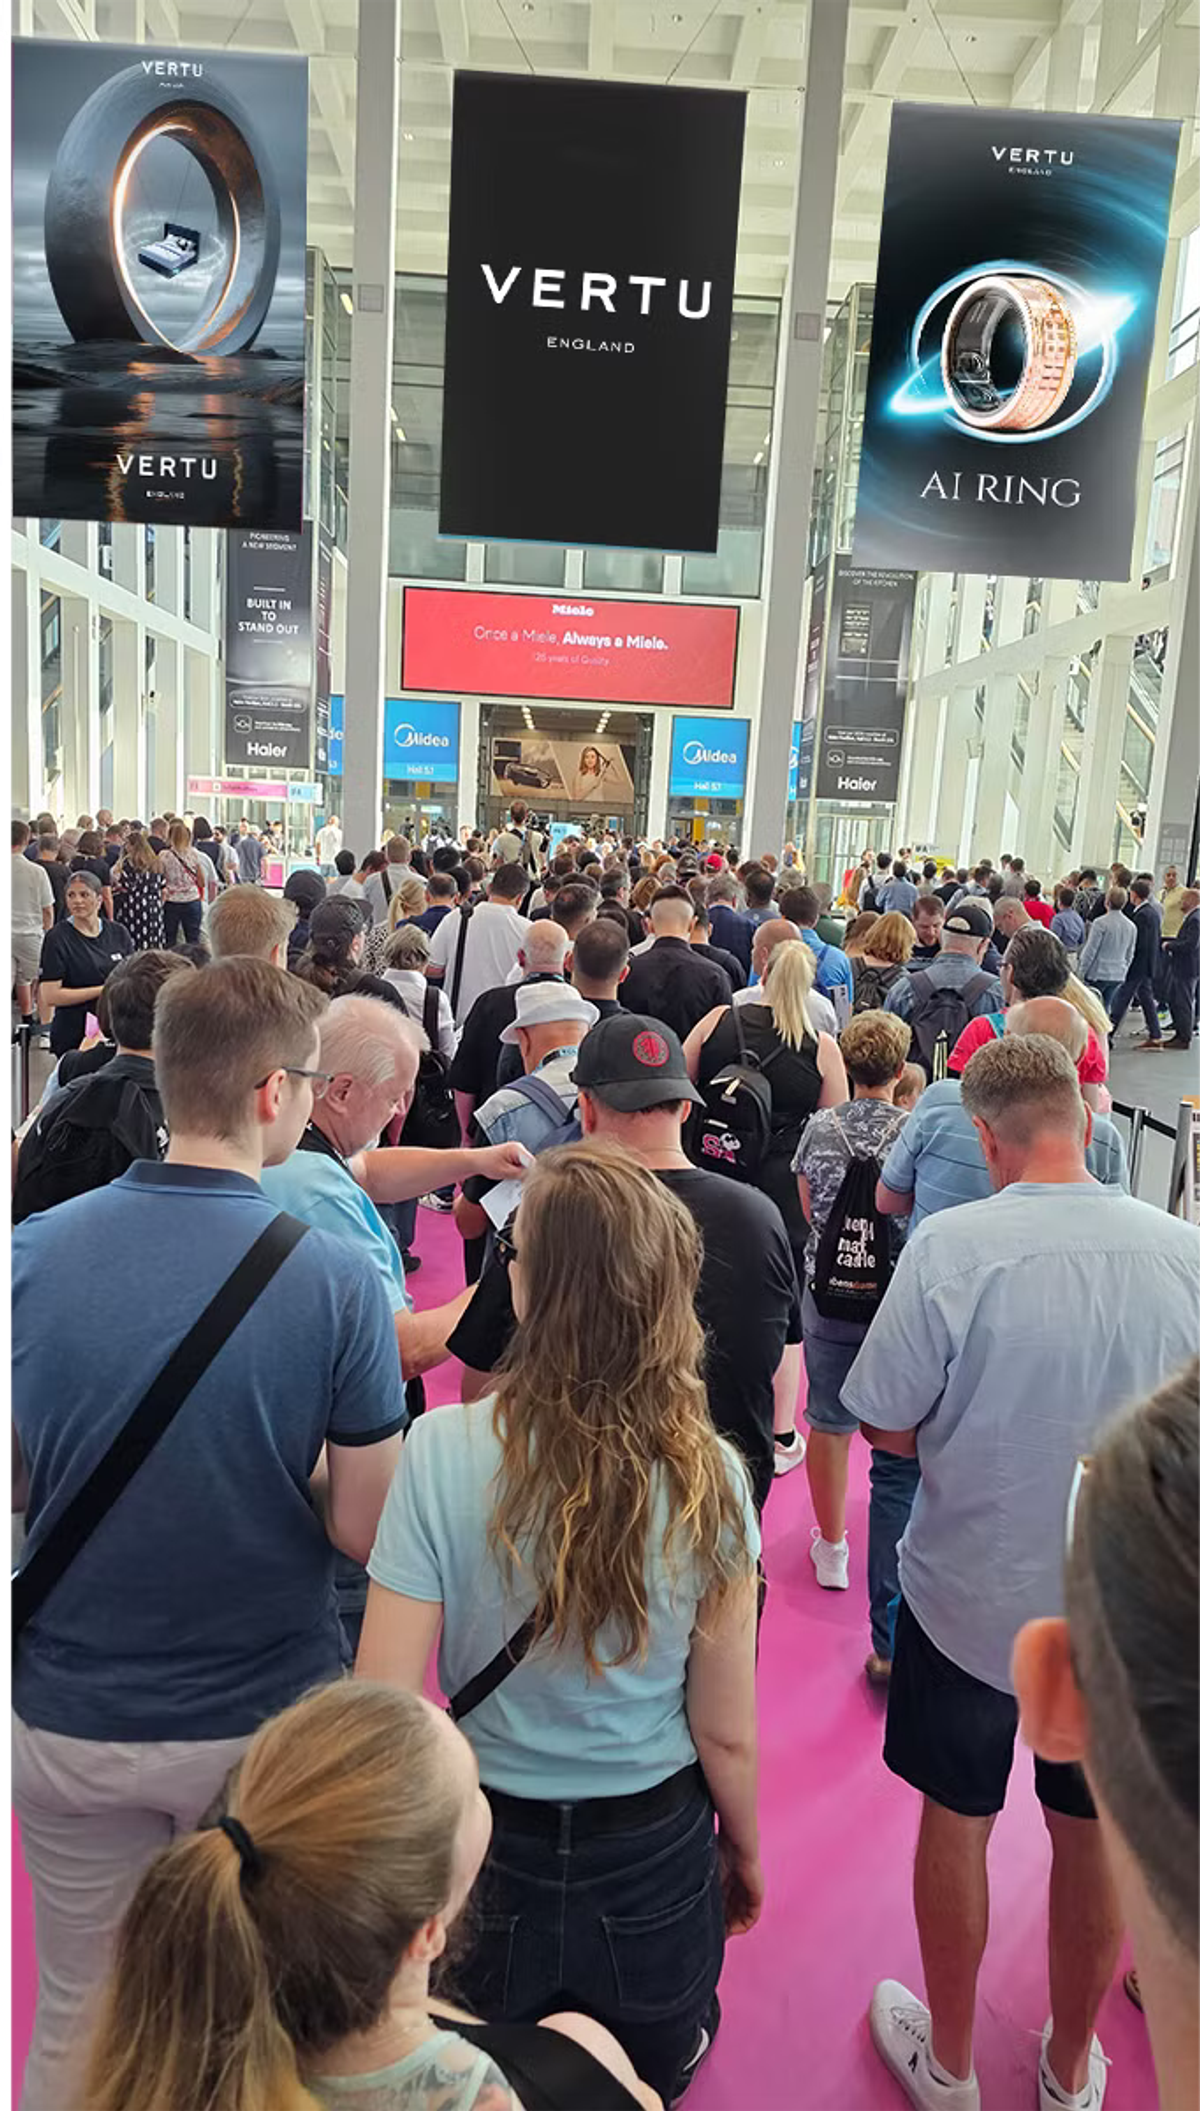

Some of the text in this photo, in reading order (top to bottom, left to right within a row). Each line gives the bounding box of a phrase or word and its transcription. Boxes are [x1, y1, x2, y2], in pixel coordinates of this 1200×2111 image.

[141, 60, 204, 77] VERTU
[991, 146, 1074, 166] VERTU
[480, 264, 712, 319] VERTU
[547, 336, 635, 354] ENGLAND
[116, 454, 217, 479] VERTU
[920, 470, 1081, 508] AI RING
[246, 598, 292, 610] BUILT IN
[552, 604, 595, 617] Miele
[261, 611, 277, 621] TO
[238, 621, 299, 634] STAND OUT
[474, 625, 507, 641] Once
[563, 631, 611, 650] Always
[614, 637, 623, 648] a
[626, 634, 669, 651] Miele.
[394, 723, 451, 748] Midea
[247, 742, 288, 757] Haier
[683, 740, 737, 765] Midea
[837, 776, 877, 791] Haier
